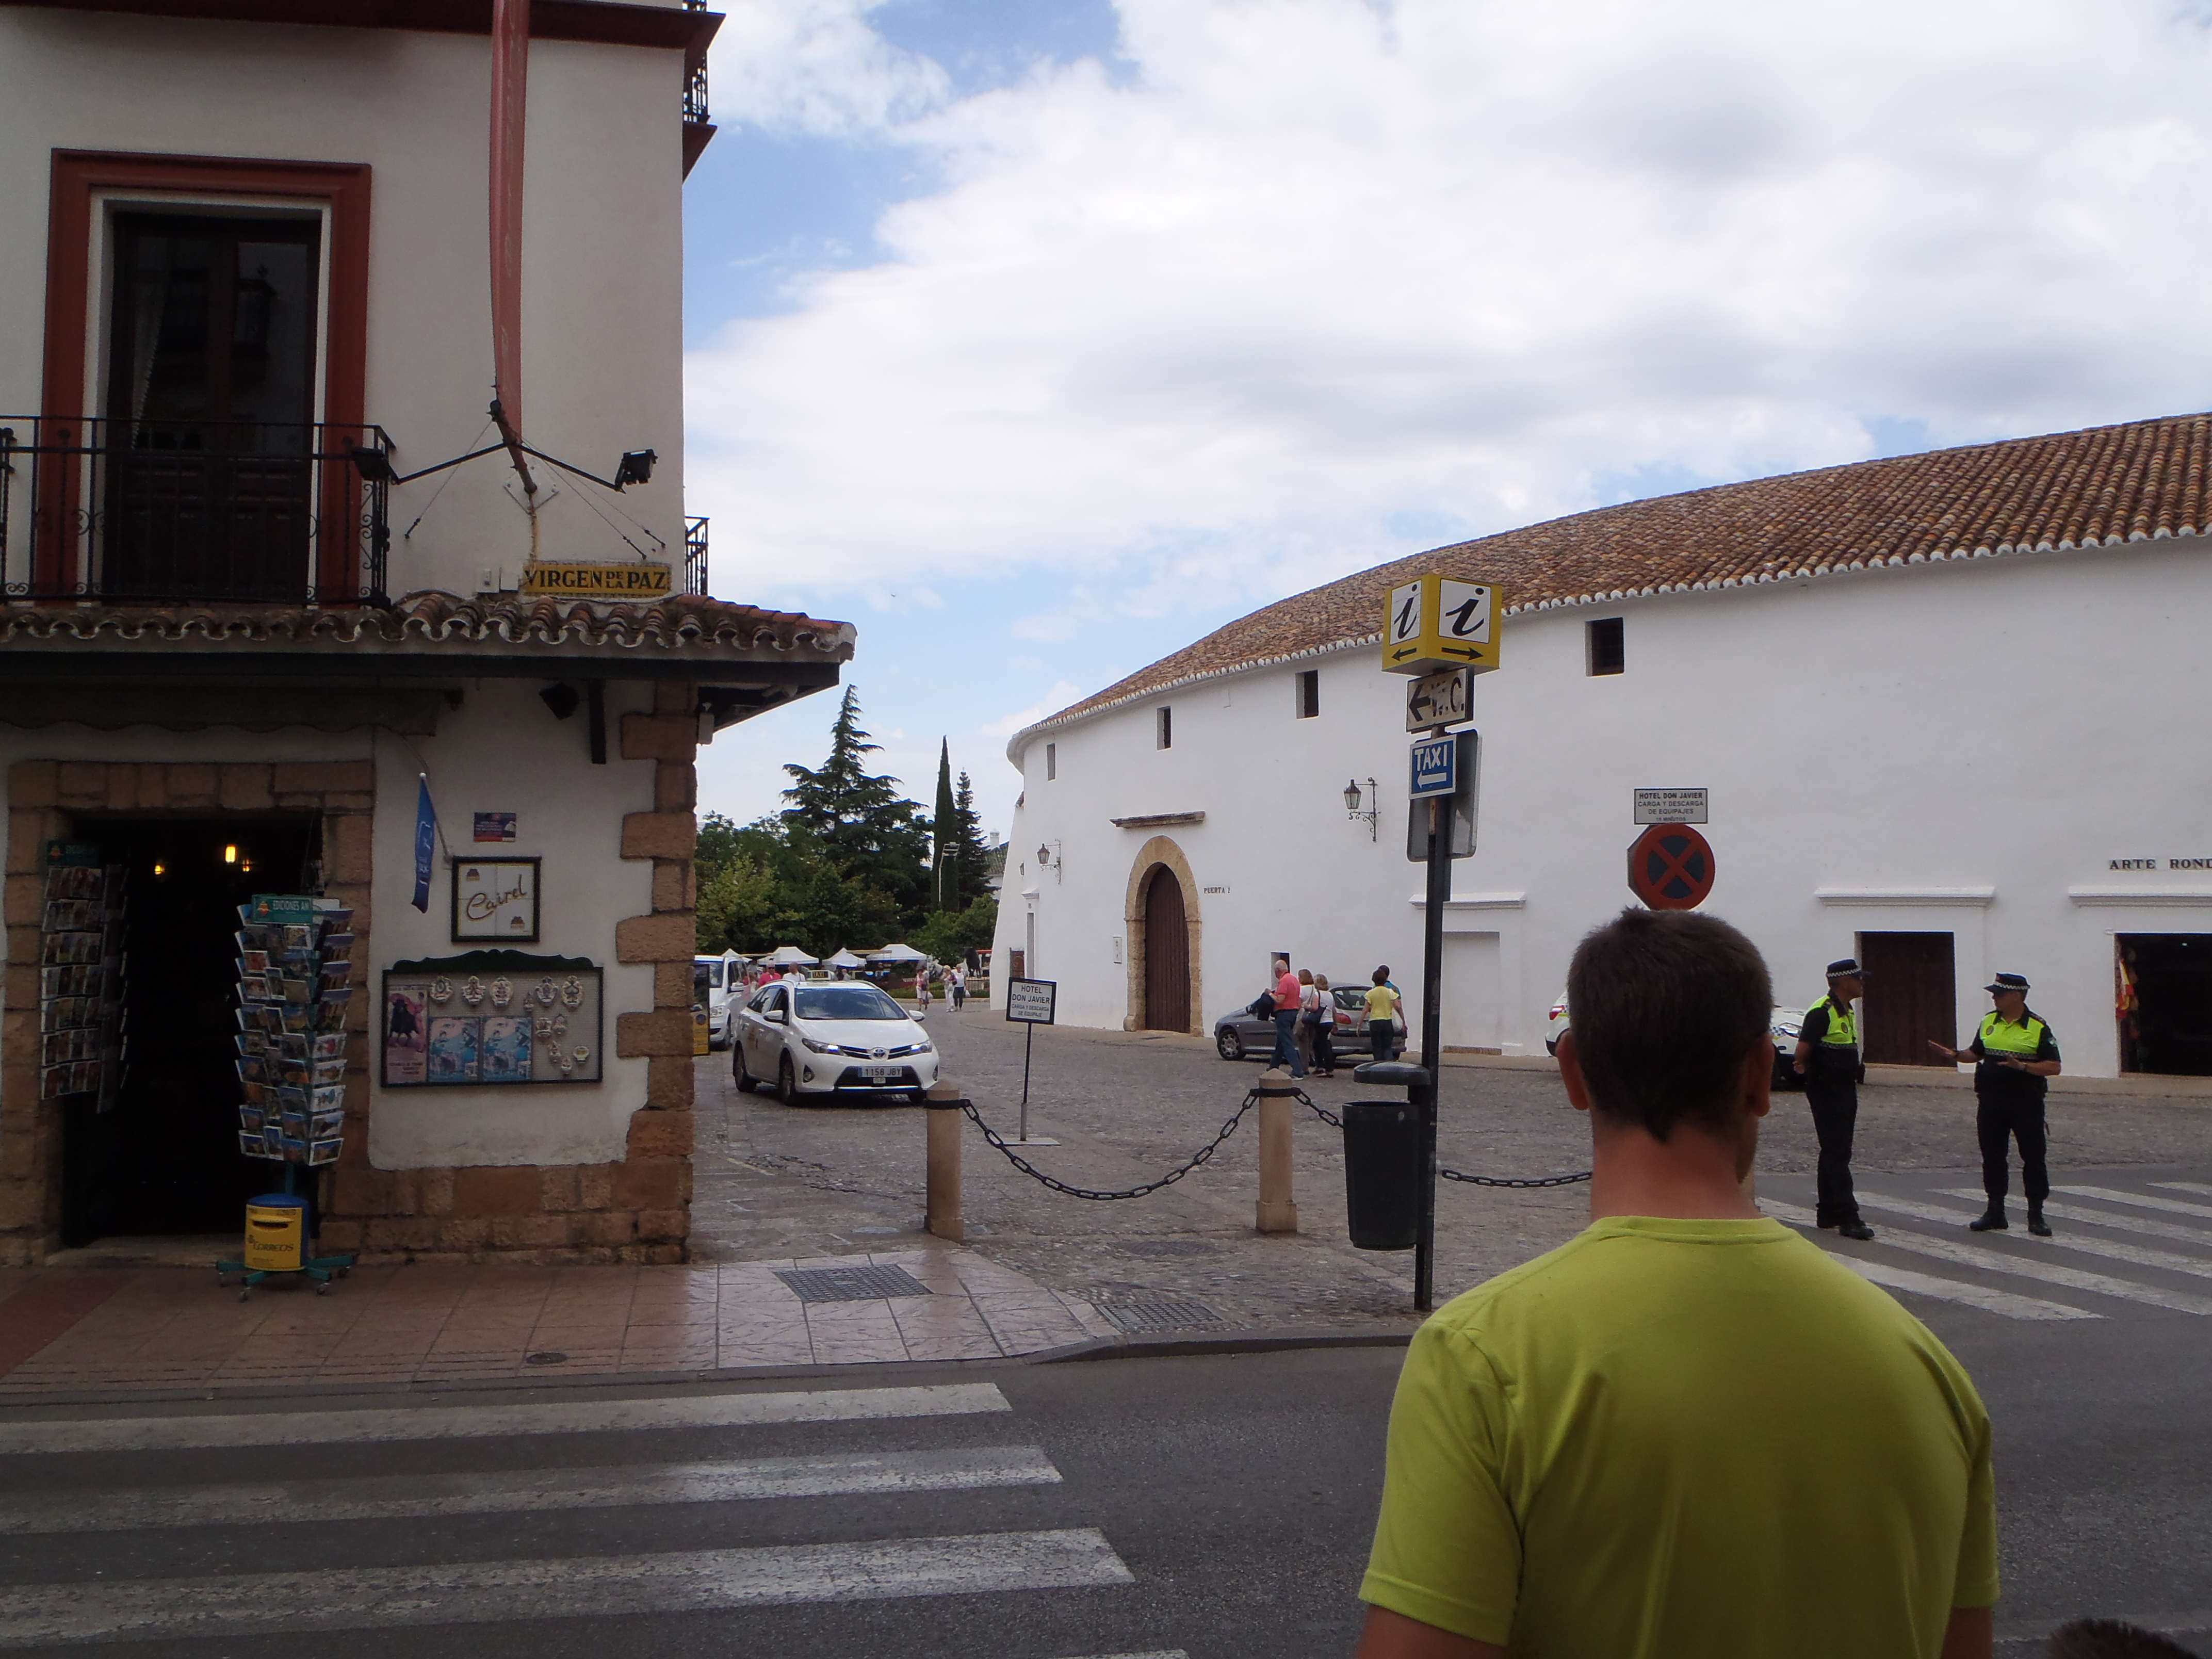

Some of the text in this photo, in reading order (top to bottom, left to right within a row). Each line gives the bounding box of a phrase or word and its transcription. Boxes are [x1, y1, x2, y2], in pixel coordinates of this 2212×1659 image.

[524, 570, 666, 590] VIRGEN DE LA PAZ
[1414, 744, 1447, 772] TAXI
[2109, 859, 2156, 870] ARTE
[466, 874, 527, 920] Cairel
[1021, 985, 1043, 994] HOTEL
[1028, 996, 1050, 1004] JAVIER
[887, 1068, 901, 1076] JBY
[253, 1241, 294, 1252] CORREOS
